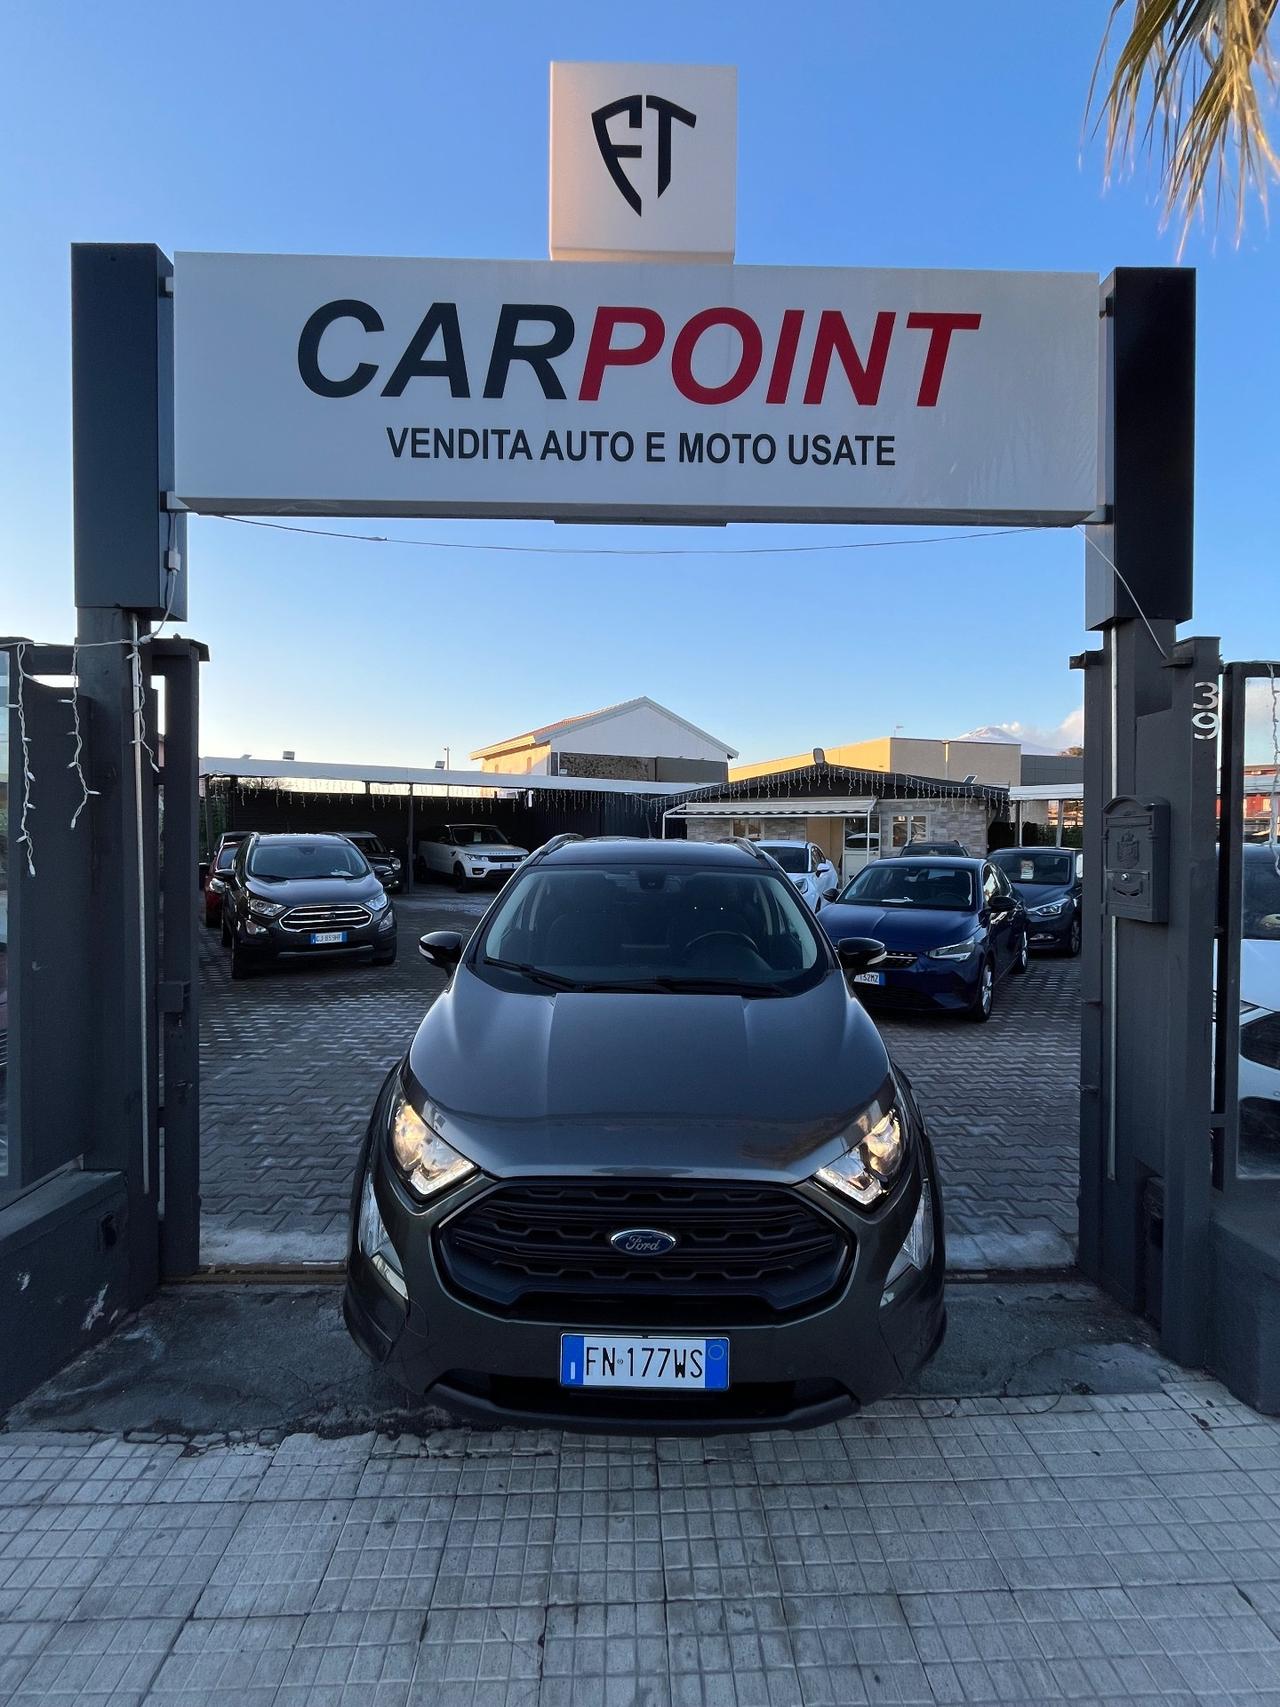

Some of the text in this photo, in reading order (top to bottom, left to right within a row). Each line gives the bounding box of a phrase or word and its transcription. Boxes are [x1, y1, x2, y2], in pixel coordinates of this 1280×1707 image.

[591, 94, 697, 217] FT
[297, 299, 982, 407] CARPOINT
[386, 427, 896, 466] VENDITA AUTO E MOTO USATE
[625, 1234, 660, 1251] Ford
